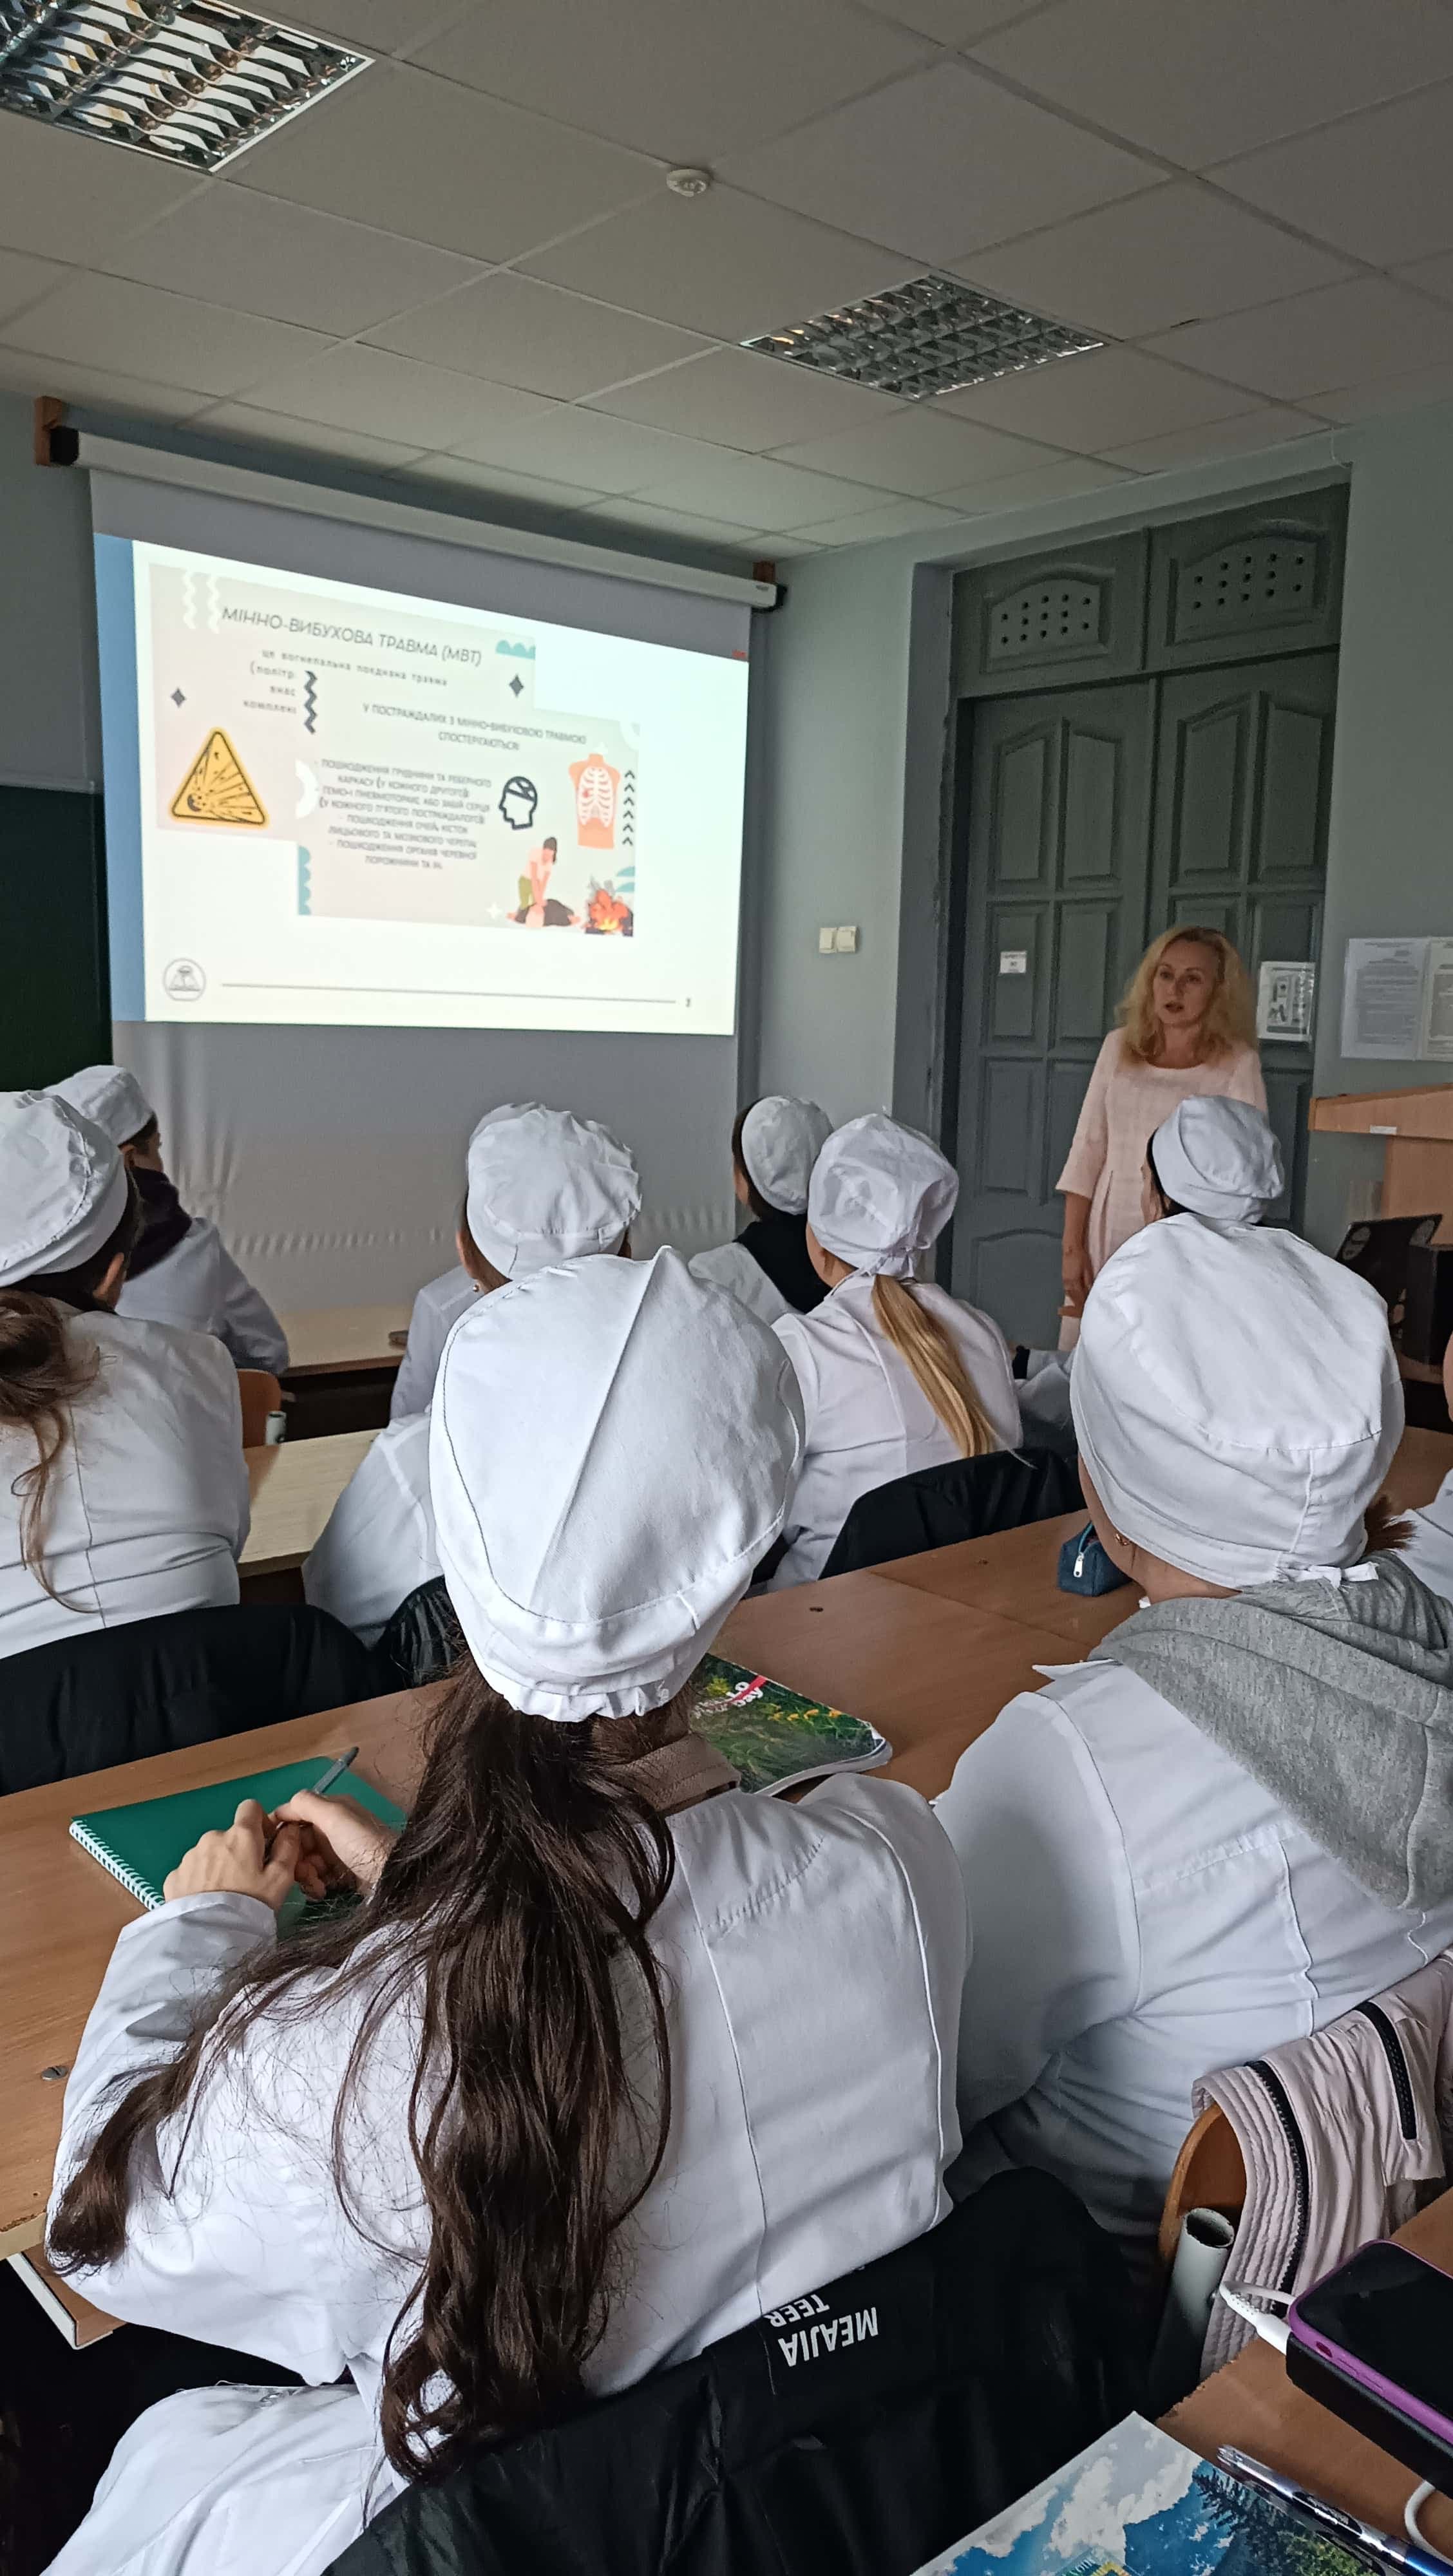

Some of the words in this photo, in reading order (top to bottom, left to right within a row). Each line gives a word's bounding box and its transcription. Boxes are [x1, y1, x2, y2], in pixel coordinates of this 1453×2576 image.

[222, 607, 373, 645] МІННО-ВИБУХОВА
[379, 633, 438, 656] ТРАВМА
[442, 644, 482, 667] (МВТ)
[763, 2294, 830, 2327] TEER
